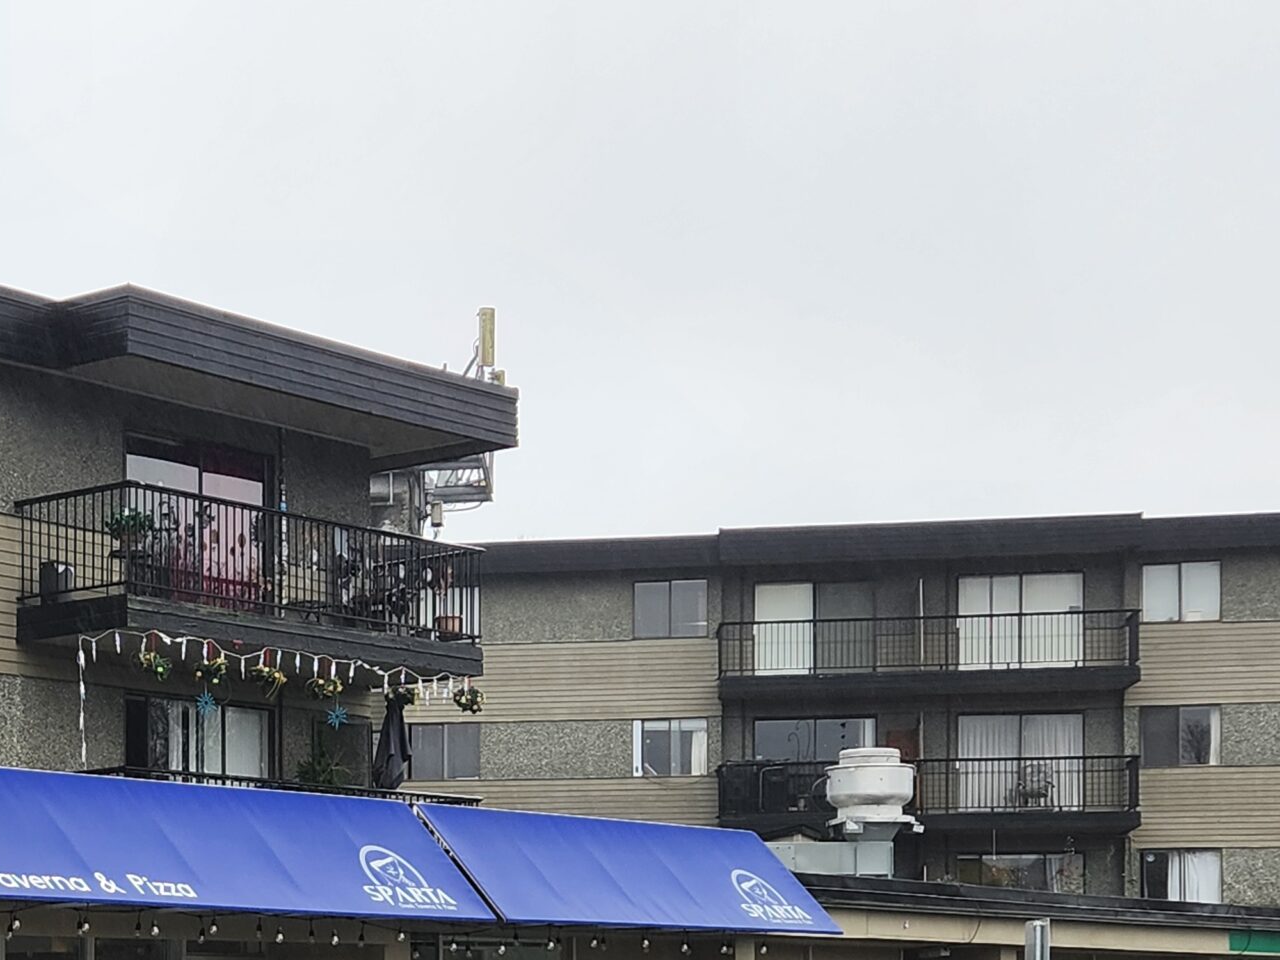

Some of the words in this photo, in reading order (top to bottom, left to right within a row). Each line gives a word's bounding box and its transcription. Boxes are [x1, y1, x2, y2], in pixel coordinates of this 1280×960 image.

[95, 872, 126, 894] &
[126, 873, 197, 898] Pizza
[363, 885, 458, 906] SPARTA
[740, 903, 813, 920] SPARTA
